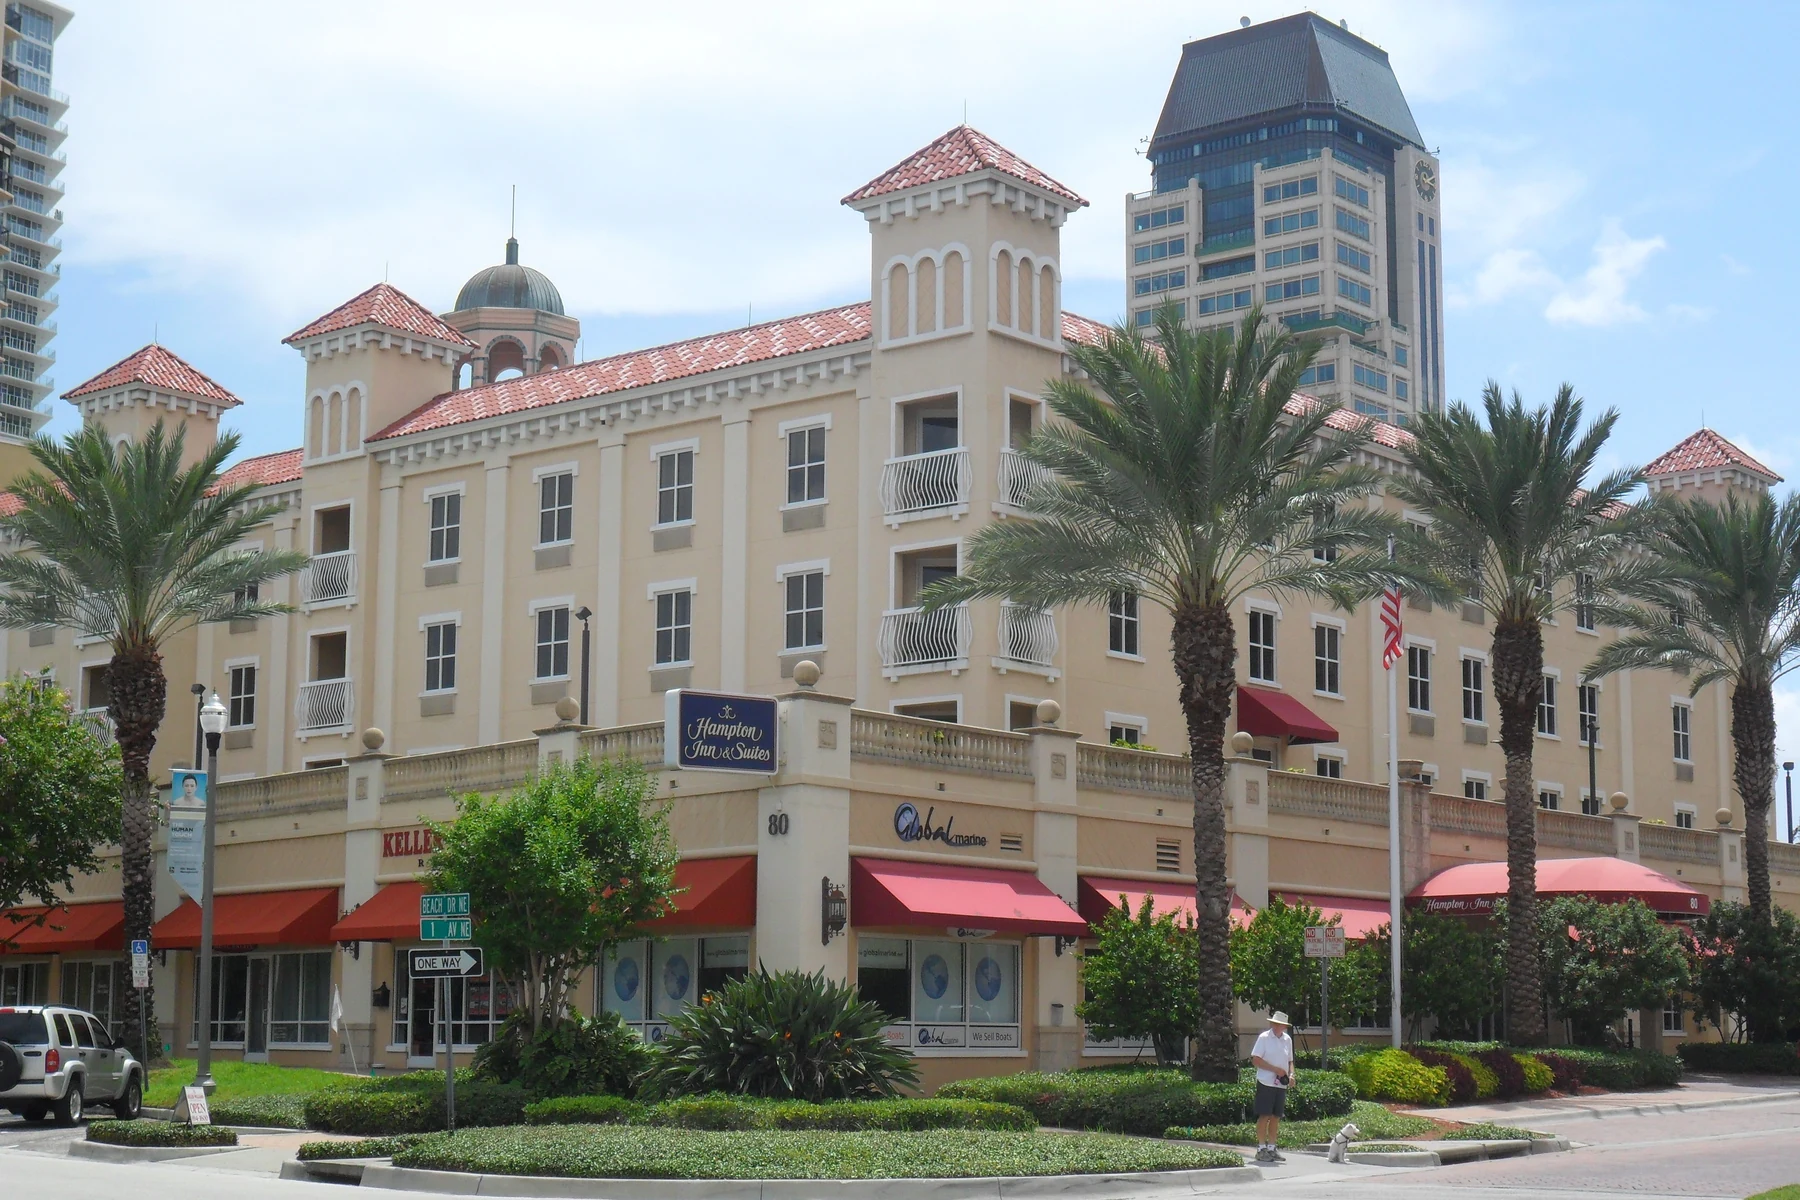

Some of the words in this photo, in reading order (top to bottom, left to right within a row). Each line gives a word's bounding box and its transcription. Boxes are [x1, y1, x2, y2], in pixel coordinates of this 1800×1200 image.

[687, 717, 763, 741] Hampton
[685, 740, 722, 759] Inn
[722, 747, 732, 760] &
[731, 742, 770, 761] Suites
[768, 813, 789, 835] 80
[894, 803, 954, 846] Global
[955, 834, 987, 846] marine
[422, 897, 443, 914] BEACH
[447, 897, 456, 913] DR
[459, 896, 467, 912] NE
[1424, 899, 1468, 912] Hampton
[1690, 897, 1698, 909] 80
[430, 922, 435, 937] 1
[448, 922, 457, 937] AV
[461, 922, 470, 937] NE
[1306, 929, 1315, 937] NO
[1326, 929, 1335, 937] NO
[418, 958, 437, 969] ONE
[441, 957, 461, 968] WAY
[887, 1031, 905, 1040] Boats
[972, 1033, 982, 1041] We
[984, 1033, 994, 1041] Sell
[995, 1033, 1012, 1041] Boats
